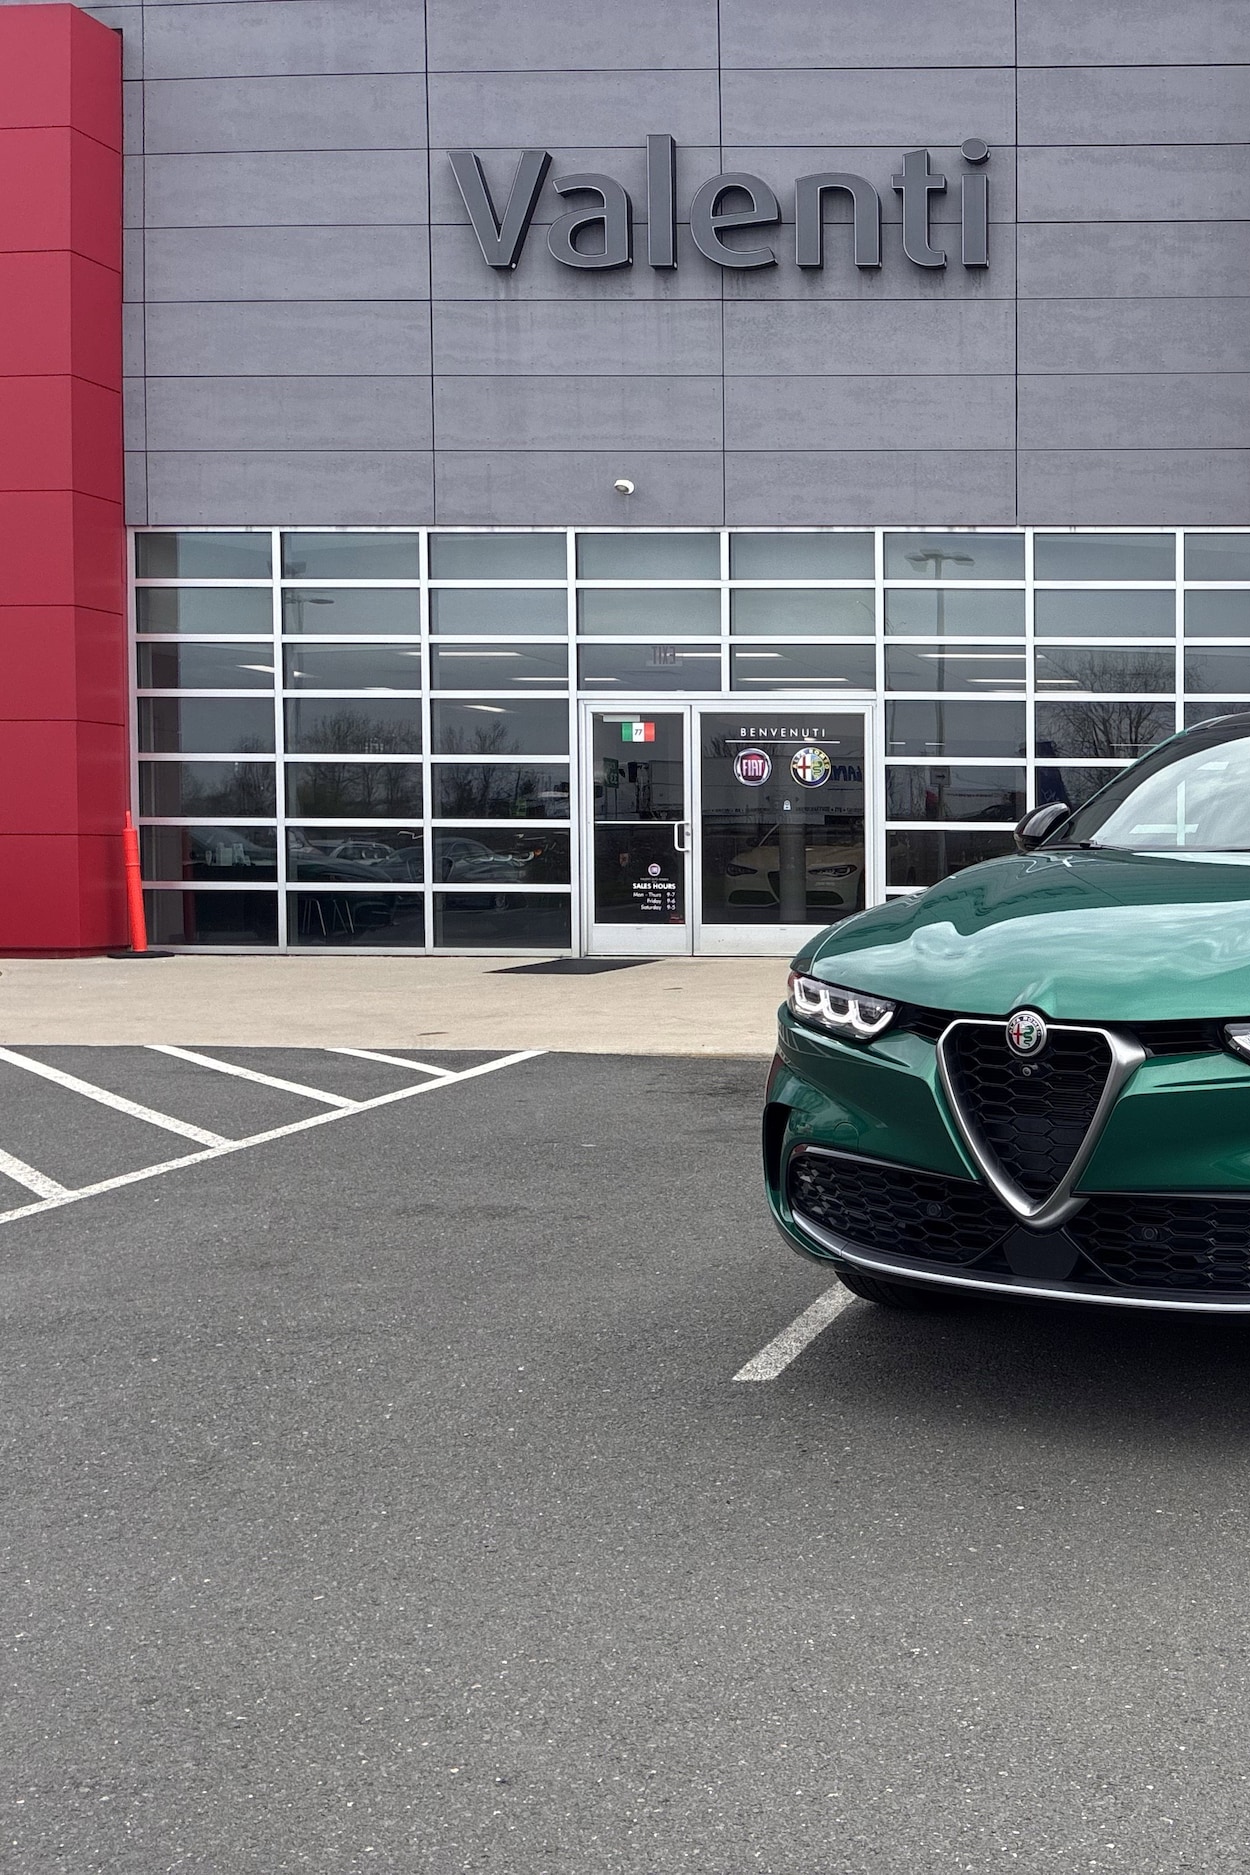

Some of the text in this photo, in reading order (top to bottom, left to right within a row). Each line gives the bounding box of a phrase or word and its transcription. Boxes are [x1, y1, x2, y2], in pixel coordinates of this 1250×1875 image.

[446, 133, 991, 270] Valenti
[634, 728, 643, 736] 77
[740, 727, 826, 738] BENVENUTI
[742, 759, 764, 777] FIAT
